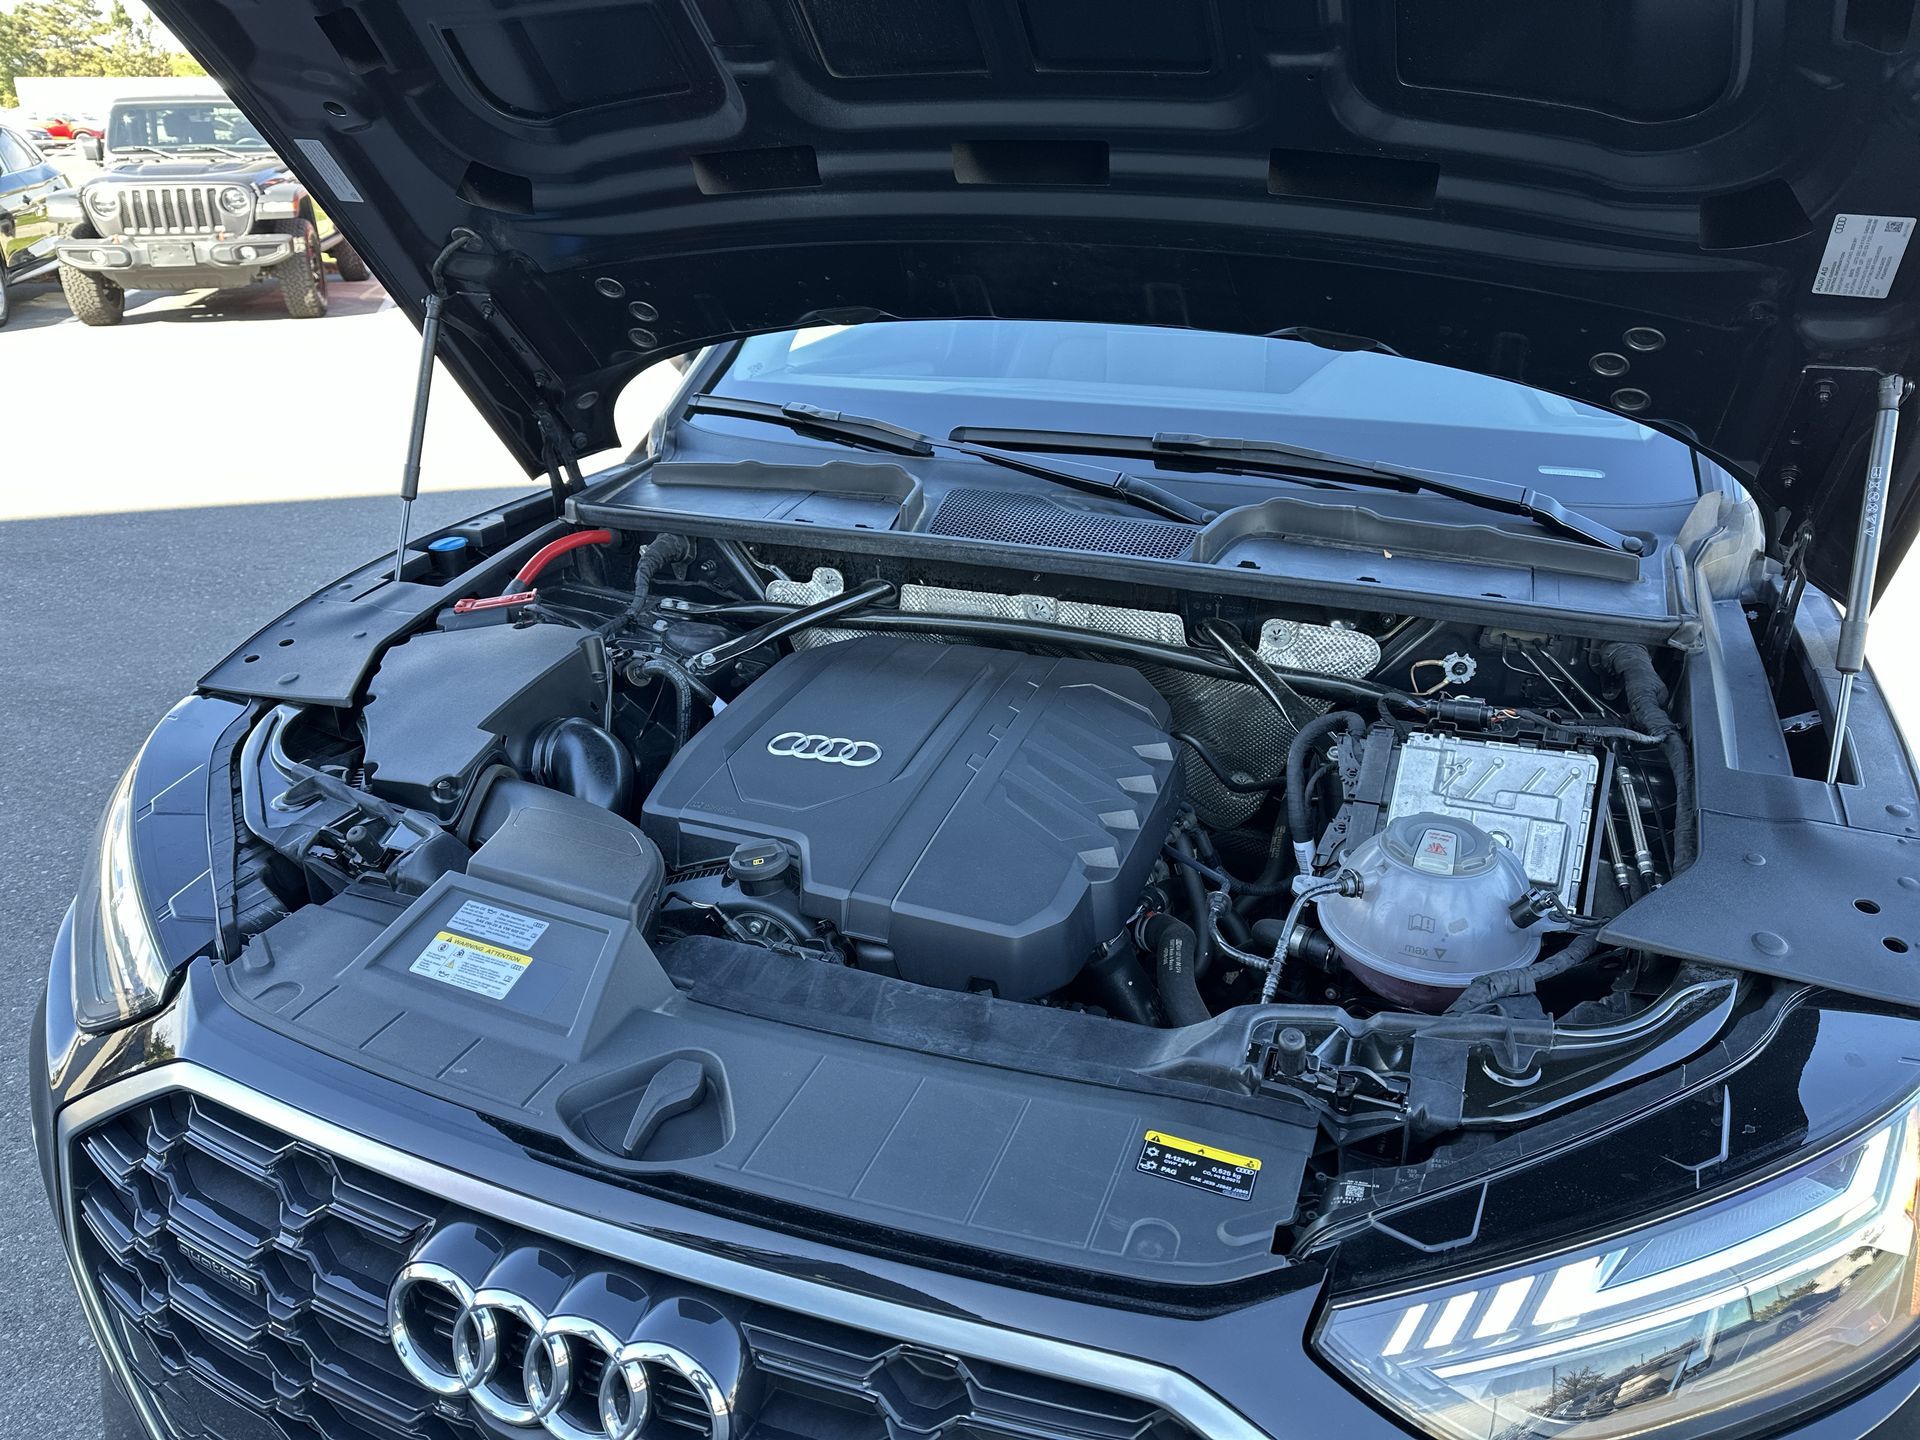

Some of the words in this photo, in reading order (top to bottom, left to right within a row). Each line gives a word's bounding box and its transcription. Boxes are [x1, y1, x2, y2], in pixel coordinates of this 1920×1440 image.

[454, 939, 485, 952] WARNING
[485, 948, 522, 963] ATTENTION
[1404, 944, 1429, 957] max
[1164, 1153, 1197, 1167] R-1234yf
[1160, 1166, 1178, 1176] PAG
[1232, 1172, 1242, 1180] kg
[179, 1243, 252, 1291] quattro
